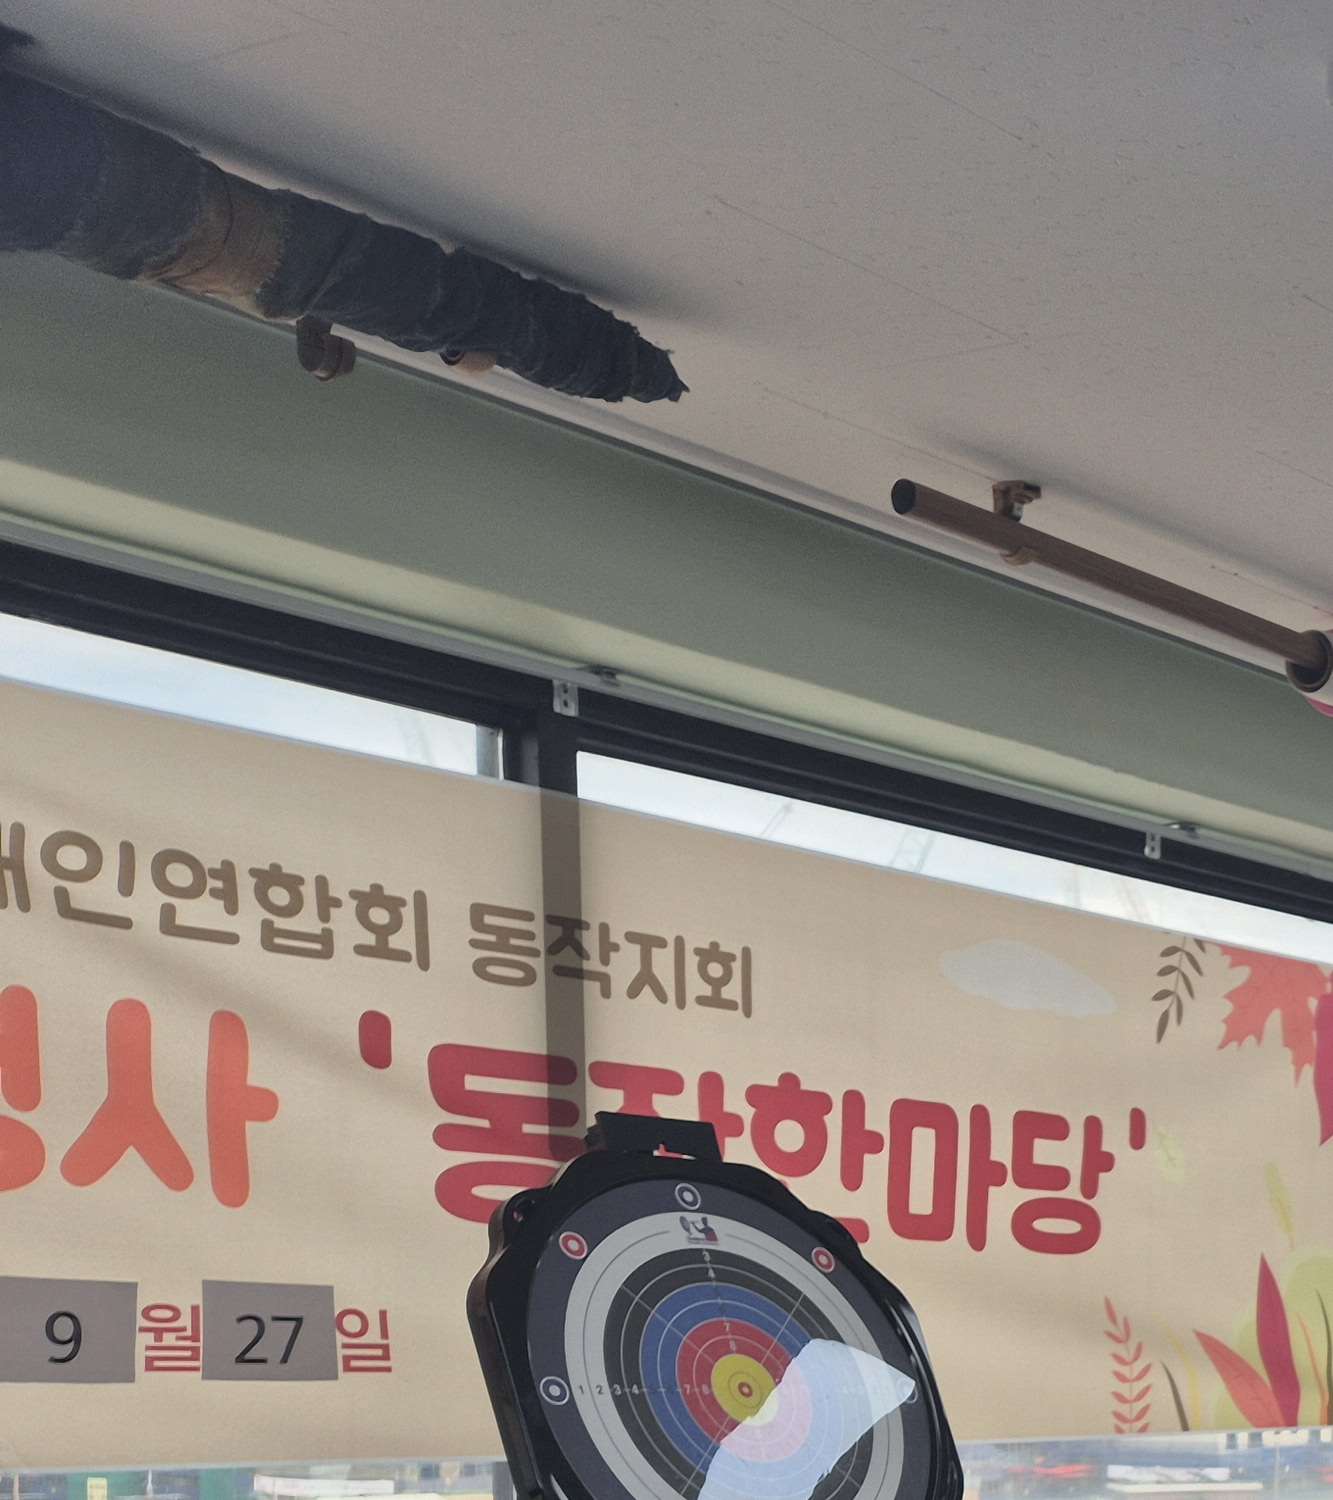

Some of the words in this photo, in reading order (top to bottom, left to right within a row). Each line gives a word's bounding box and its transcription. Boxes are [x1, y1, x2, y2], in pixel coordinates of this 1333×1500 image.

[468, 902, 753, 1019] 동작지회
[44, 1310, 83, 1365] 9
[138, 1302, 201, 1372] 월
[234, 1314, 305, 1365] 27
[335, 1308, 393, 1373] 일
[578, 1385, 585, 1395] 1
[595, 1385, 604, 1395] 2
[612, 1384, 622, 1396] 3
[630, 1384, 640, 1395] 4
